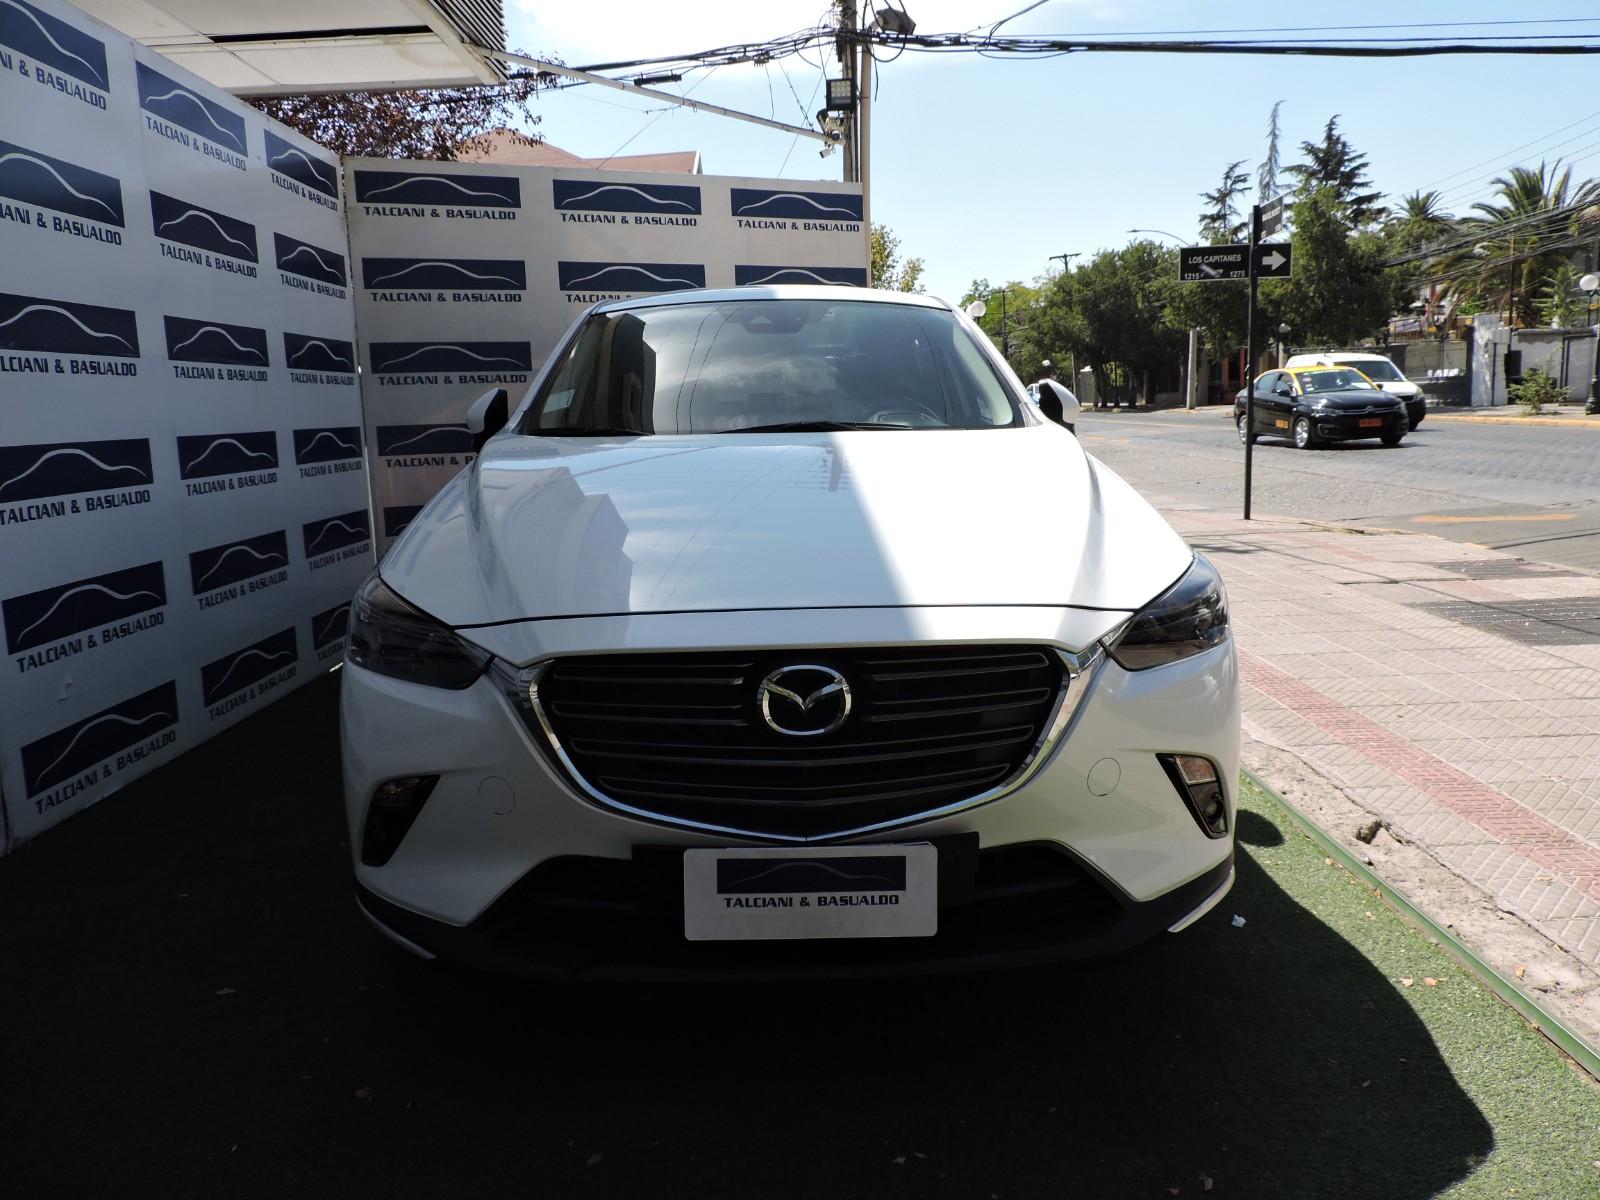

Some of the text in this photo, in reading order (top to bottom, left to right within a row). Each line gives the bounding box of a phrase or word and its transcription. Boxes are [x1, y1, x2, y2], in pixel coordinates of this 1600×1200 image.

[19, 60, 30, 77] &
[36, 66, 106, 110] BASUALDO
[145, 116, 246, 171] TALCIANI & BASUALDO
[271, 172, 338, 211] TALCIANI & BASUALDO
[363, 206, 516, 220] TALCIANI & BASUALDO
[560, 213, 697, 227] TALCIANI & BASUALDO
[37, 212, 47, 228] &
[53, 216, 122, 245] BASUALDO
[737, 219, 859, 232] TALCIANI & BASUALDO
[160, 243, 257, 278] TALCIANI & BASUALDO
[1189, 254, 1242, 264] LOS CAPITANES
[1184, 270, 1246, 280] 1215 1275
[281, 273, 346, 300] TALCIANI & BASUALDO
[371, 292, 522, 303] TALCIANI & BASUALDO
[55, 359, 65, 373] &
[71, 360, 137, 376] BASUALDO
[173, 365, 268, 381] TALCIANI & BASUALDO
[291, 373, 354, 385] TALCIANI & BASUALDO
[379, 374, 527, 386] TALCIANI & BASUALDO
[299, 461, 362, 478] TALCIANI & BASUALDO
[385, 457, 444, 468] TALCIANI
[450, 456, 459, 465] &
[185, 472, 277, 496] TALCIANI & BASUALDO
[0, 489, 150, 525] TALCIANI & BASUALDO
[198, 570, 288, 610] TALCIANI & BASUALDO
[16, 612, 164, 673] TALCIANI & BASUALDO
[209, 691, 247, 720] TALCIANI
[258, 666, 297, 695] BASUALDO
[35, 730, 176, 814] TALCIANI & BASUALDO
[724, 895, 899, 909] TALCIANI & BASUALDO
